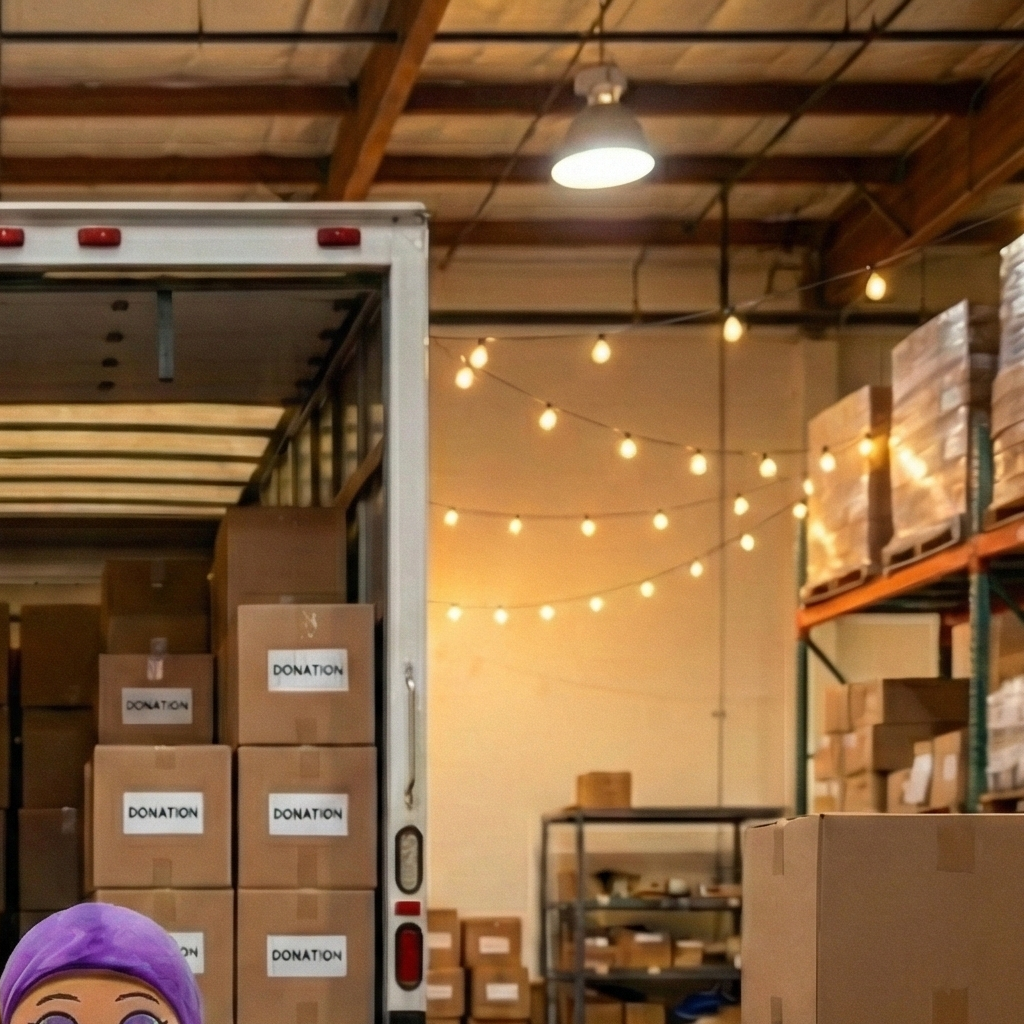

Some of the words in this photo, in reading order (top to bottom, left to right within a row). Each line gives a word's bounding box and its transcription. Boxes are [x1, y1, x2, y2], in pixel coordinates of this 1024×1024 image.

[274, 663, 344, 677] DONATION
[127, 700, 189, 711] DONATION
[129, 806, 198, 819] DONATION
[274, 807, 343, 821] DONATION
[272, 949, 342, 962] DONATION
